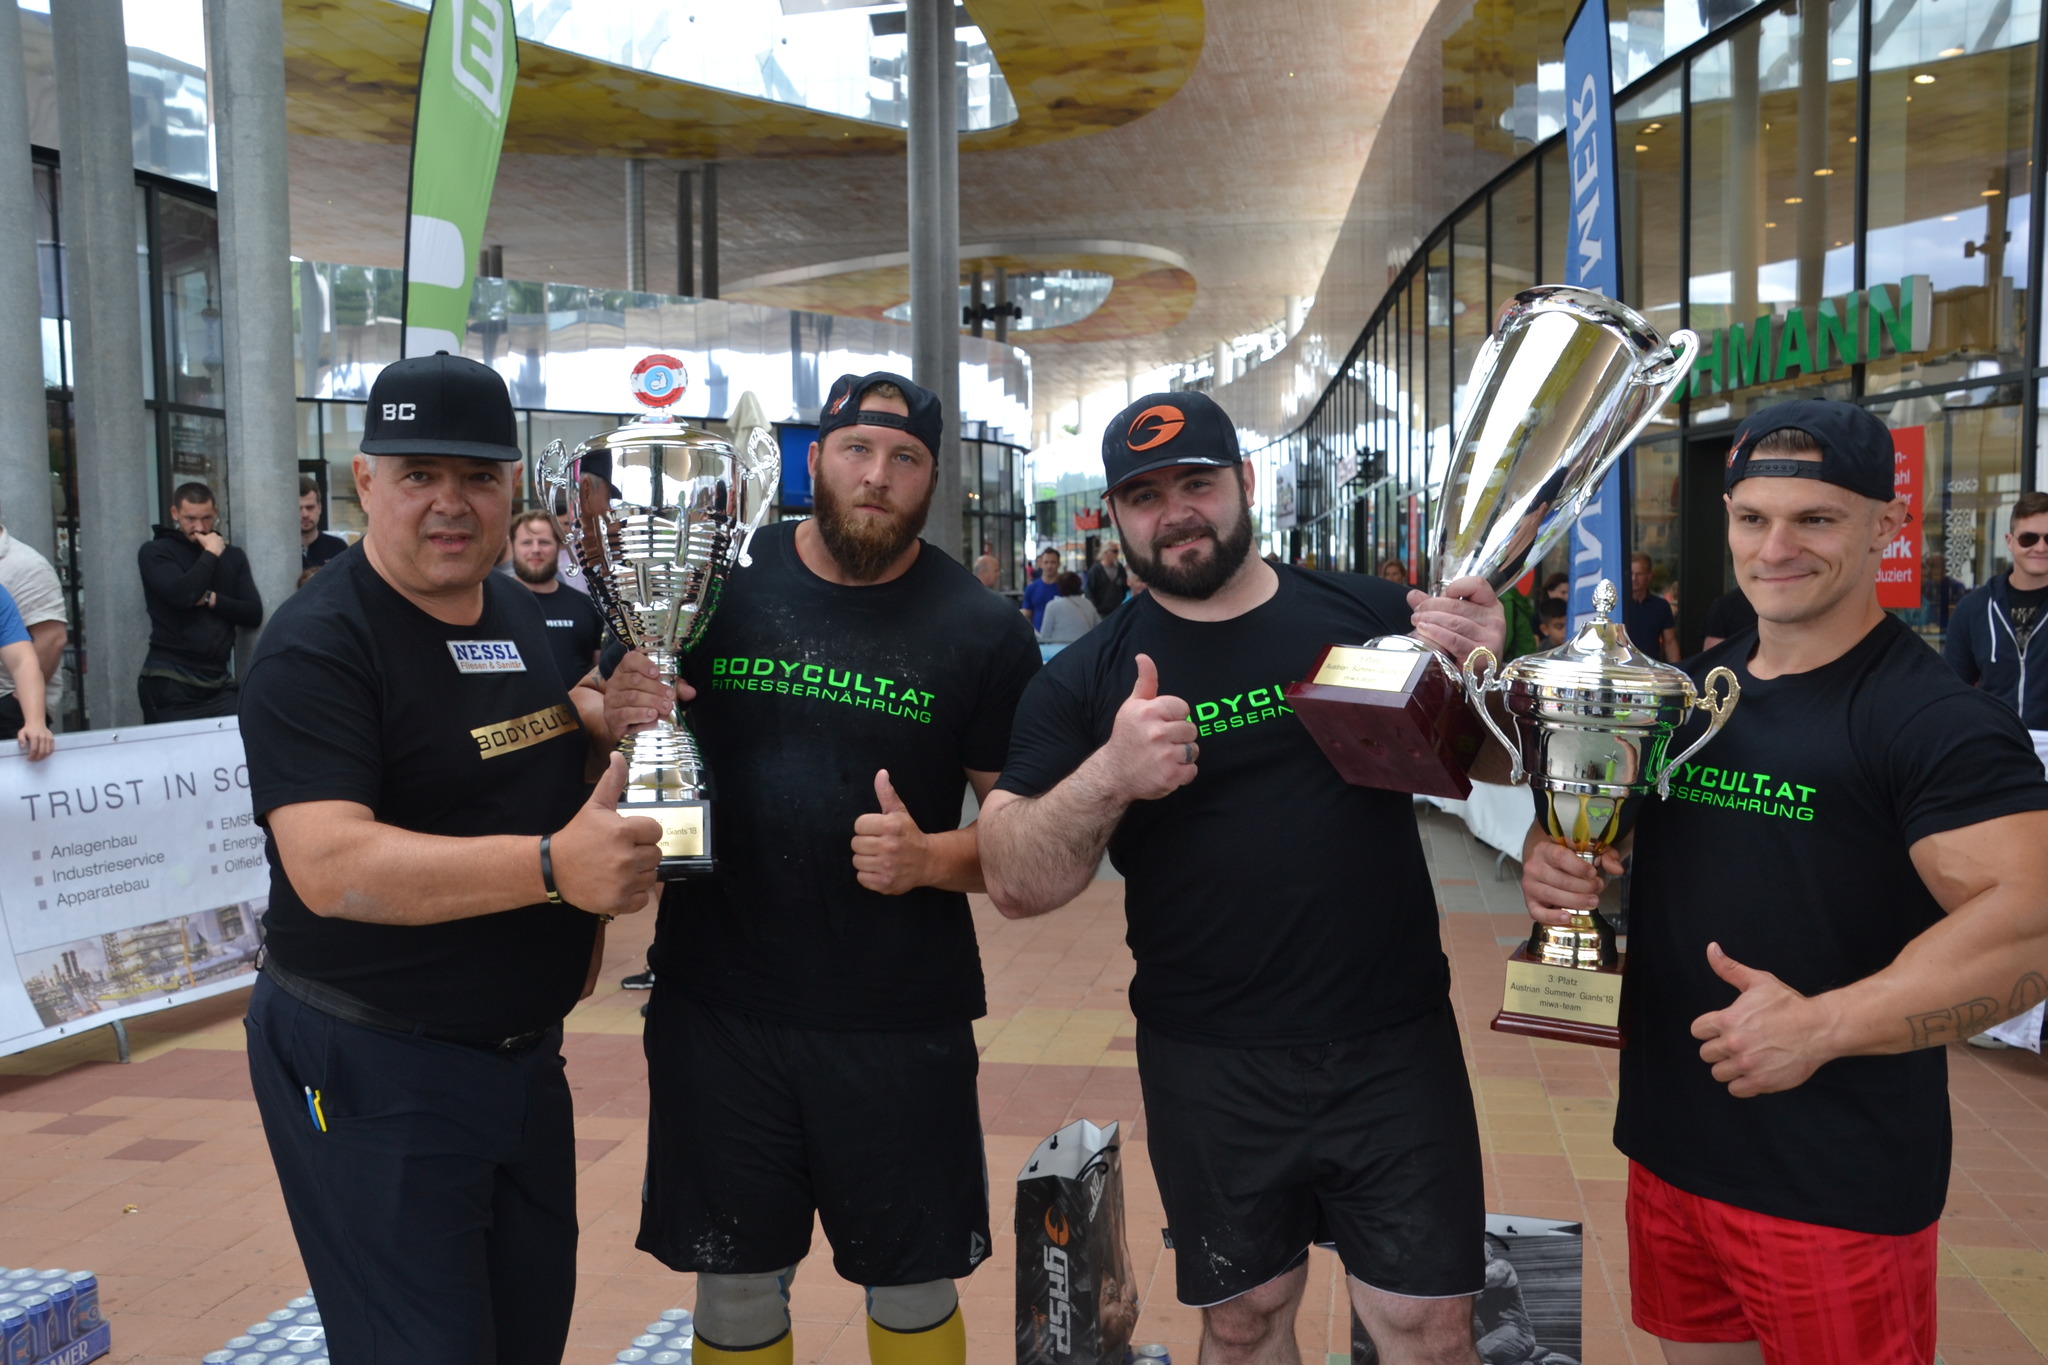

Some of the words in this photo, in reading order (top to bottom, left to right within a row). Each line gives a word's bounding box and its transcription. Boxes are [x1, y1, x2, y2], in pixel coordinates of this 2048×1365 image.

[382, 402, 417, 421] BC
[1893, 469, 1911, 486] ahl
[1882, 535, 1913, 559] ark
[1875, 566, 1913, 583] duziert
[453, 644, 519, 661] NESSL
[460, 661, 487, 670] Fliesen
[489, 662, 495, 670] &
[497, 661, 522, 670] Sanitär
[712, 657, 935, 708] BODYCULT.AT
[711, 678, 932, 724] FITNESSERNÄHRUNG
[20, 779, 143, 822] TRUST
[164, 771, 197, 801] IN
[1667, 783, 1815, 822] SSERNÄHRUNG
[50, 834, 138, 860] Anlagenbau
[52, 852, 166, 883] Industrieservice
[224, 854, 263, 873] Oilfield
[56, 877, 150, 908] Apparatebau
[1547, 974, 1556, 983] 3.
[1557, 975, 1579, 986] Platz
[1510, 982, 1541, 994] Austrian
[1544, 986, 1576, 999] Summer
[1539, 999, 1582, 1012] miwa-team
